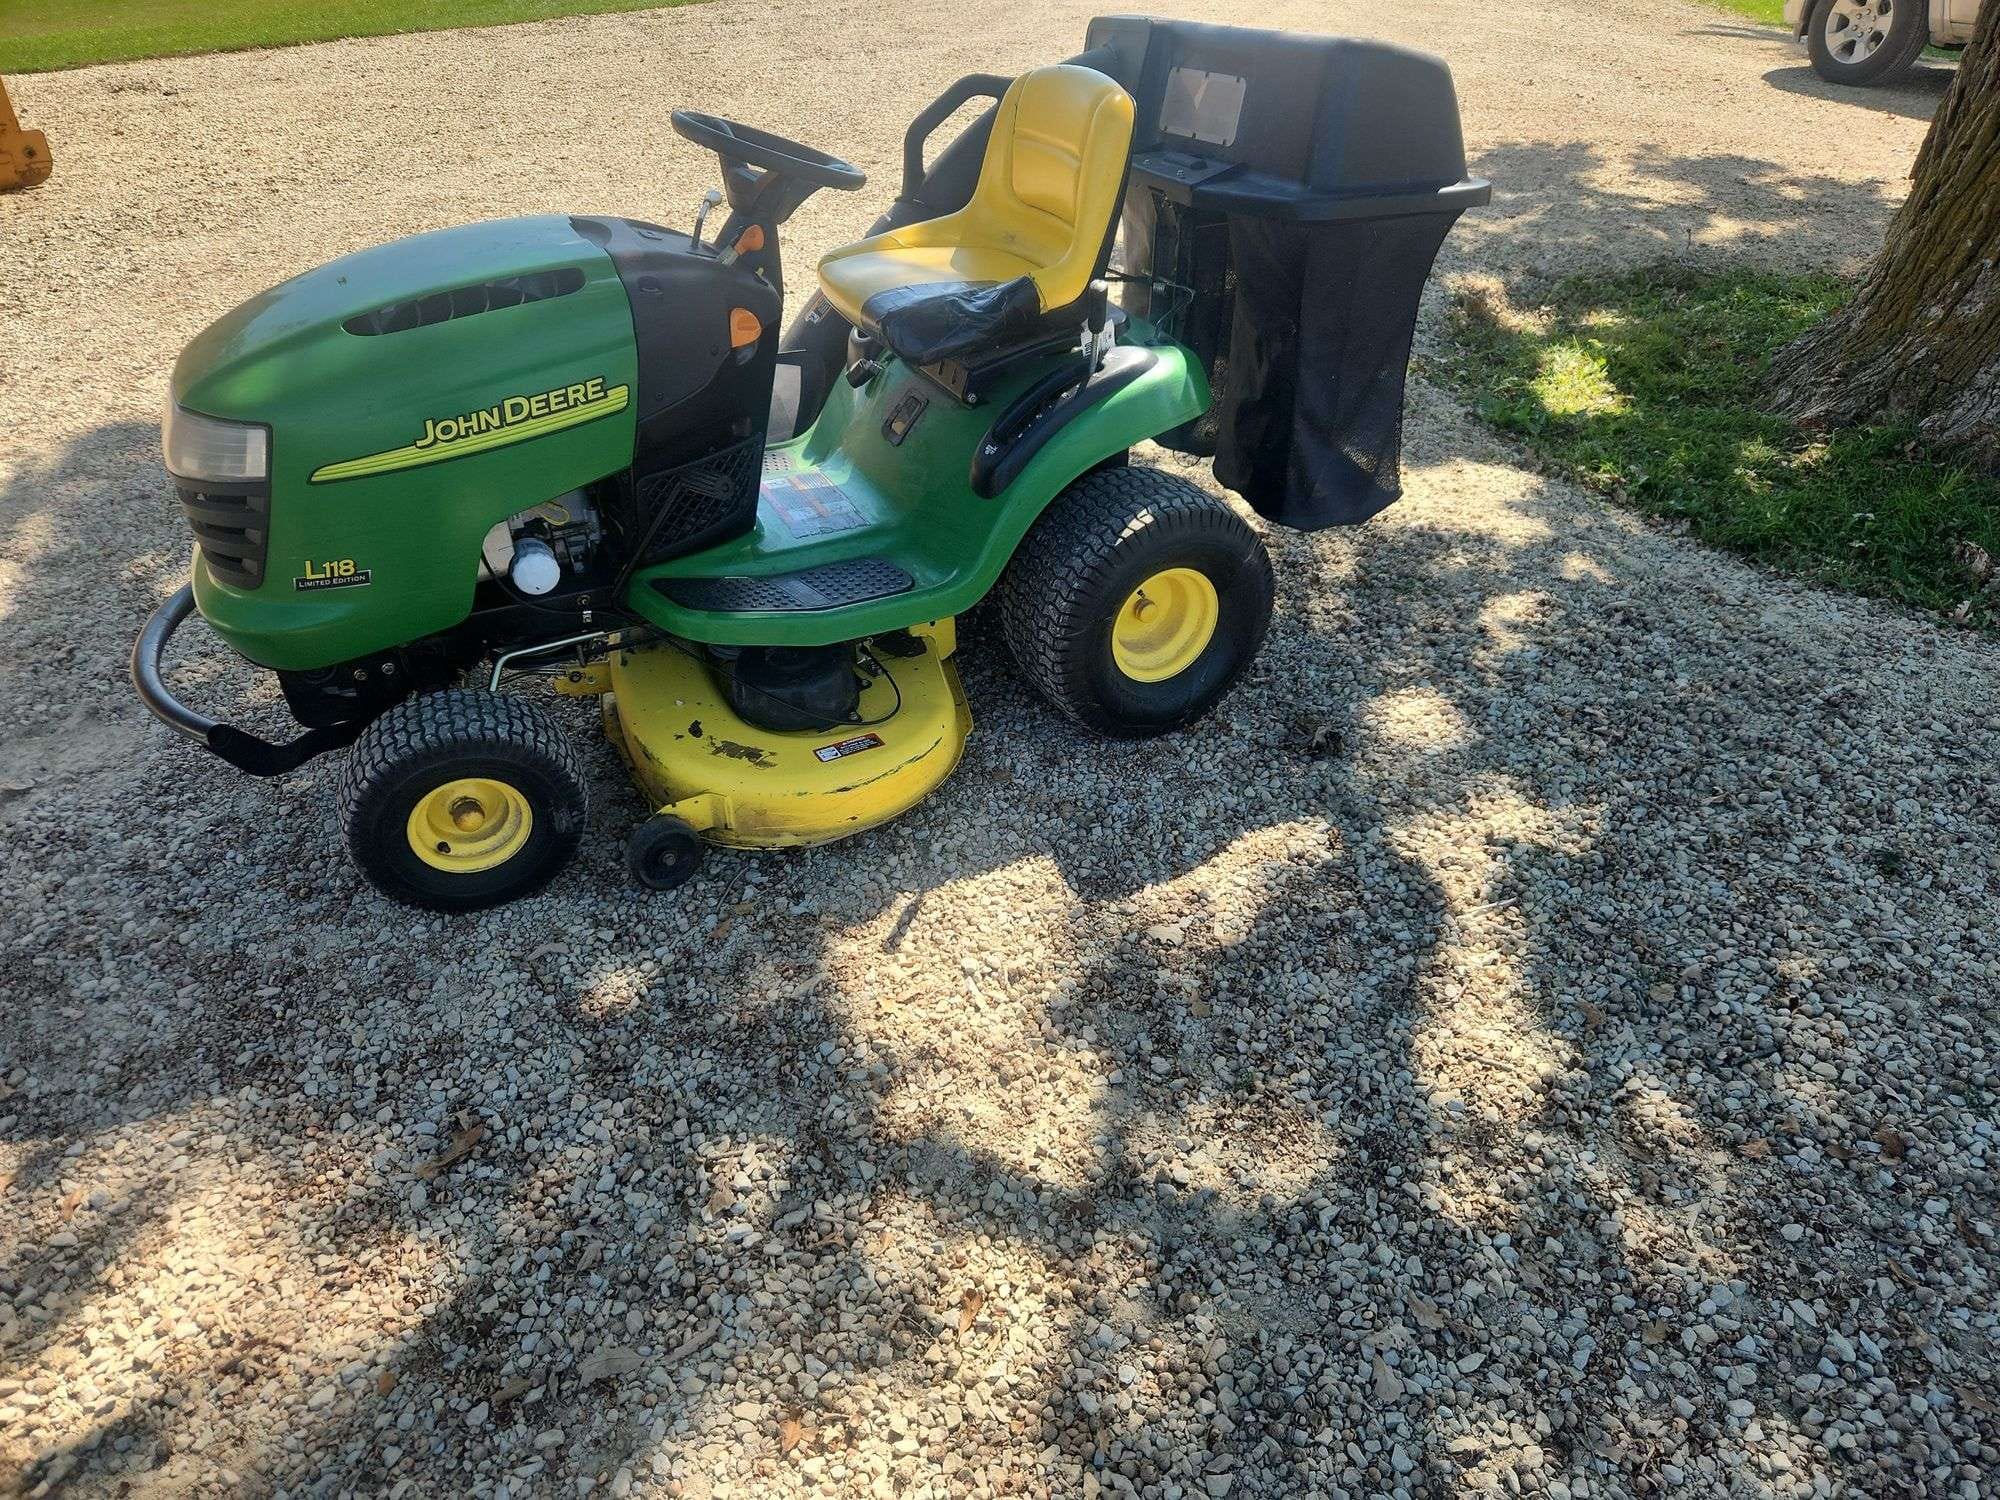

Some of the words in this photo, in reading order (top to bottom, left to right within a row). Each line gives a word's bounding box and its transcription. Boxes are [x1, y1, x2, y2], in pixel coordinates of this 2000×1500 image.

[415, 406, 500, 448] JOHN
[502, 376, 606, 424] DEERE
[304, 559, 356, 580] L118
[298, 579, 331, 588] LIMITED
[332, 575, 366, 585] EDITION
